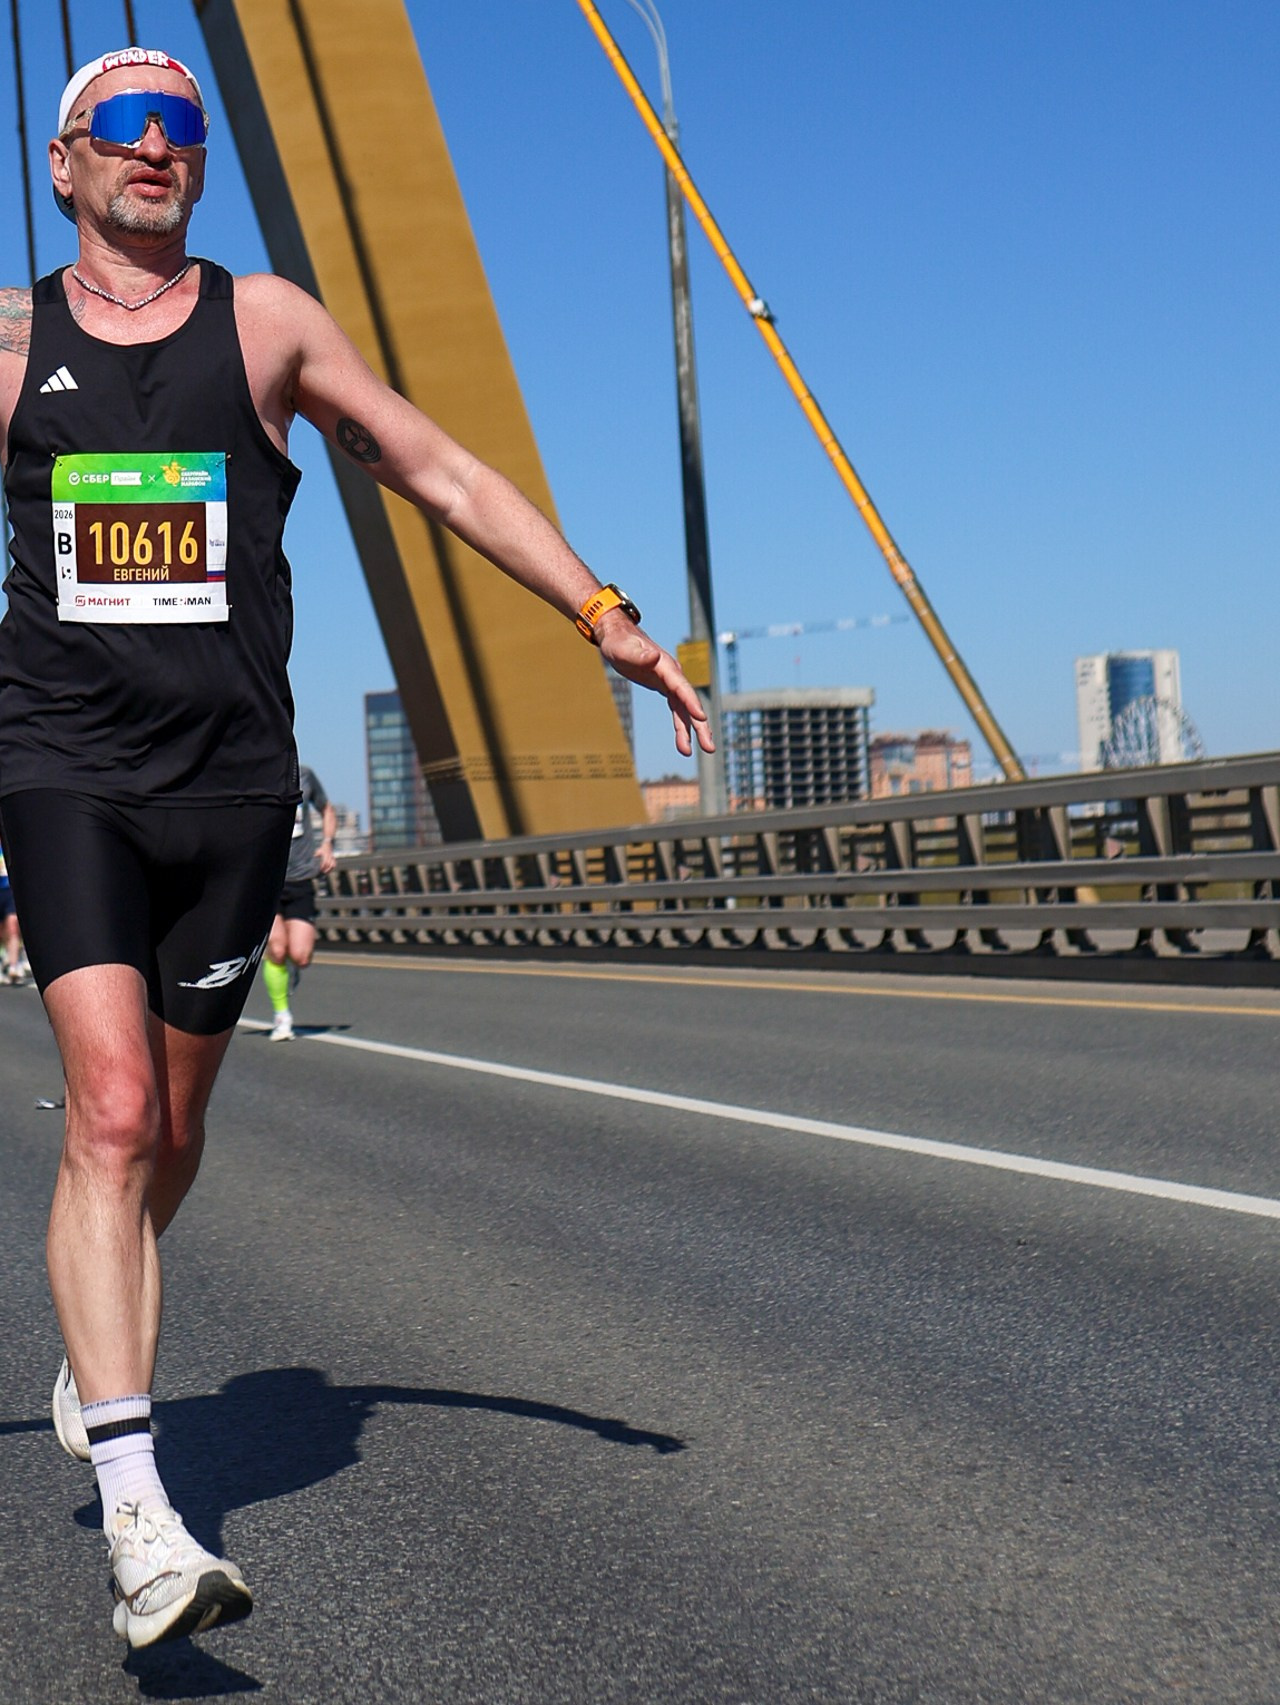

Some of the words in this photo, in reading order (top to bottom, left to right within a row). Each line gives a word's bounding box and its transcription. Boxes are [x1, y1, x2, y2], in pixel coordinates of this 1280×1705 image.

[104, 49, 169, 70] WONDER
[82, 473, 109, 484] СБЕР
[55, 509, 73, 519] 2026
[89, 521, 198, 565] 10616
[113, 565, 169, 581] ЕВГЕНИЙ
[88, 598, 131, 606] МАГНИТ
